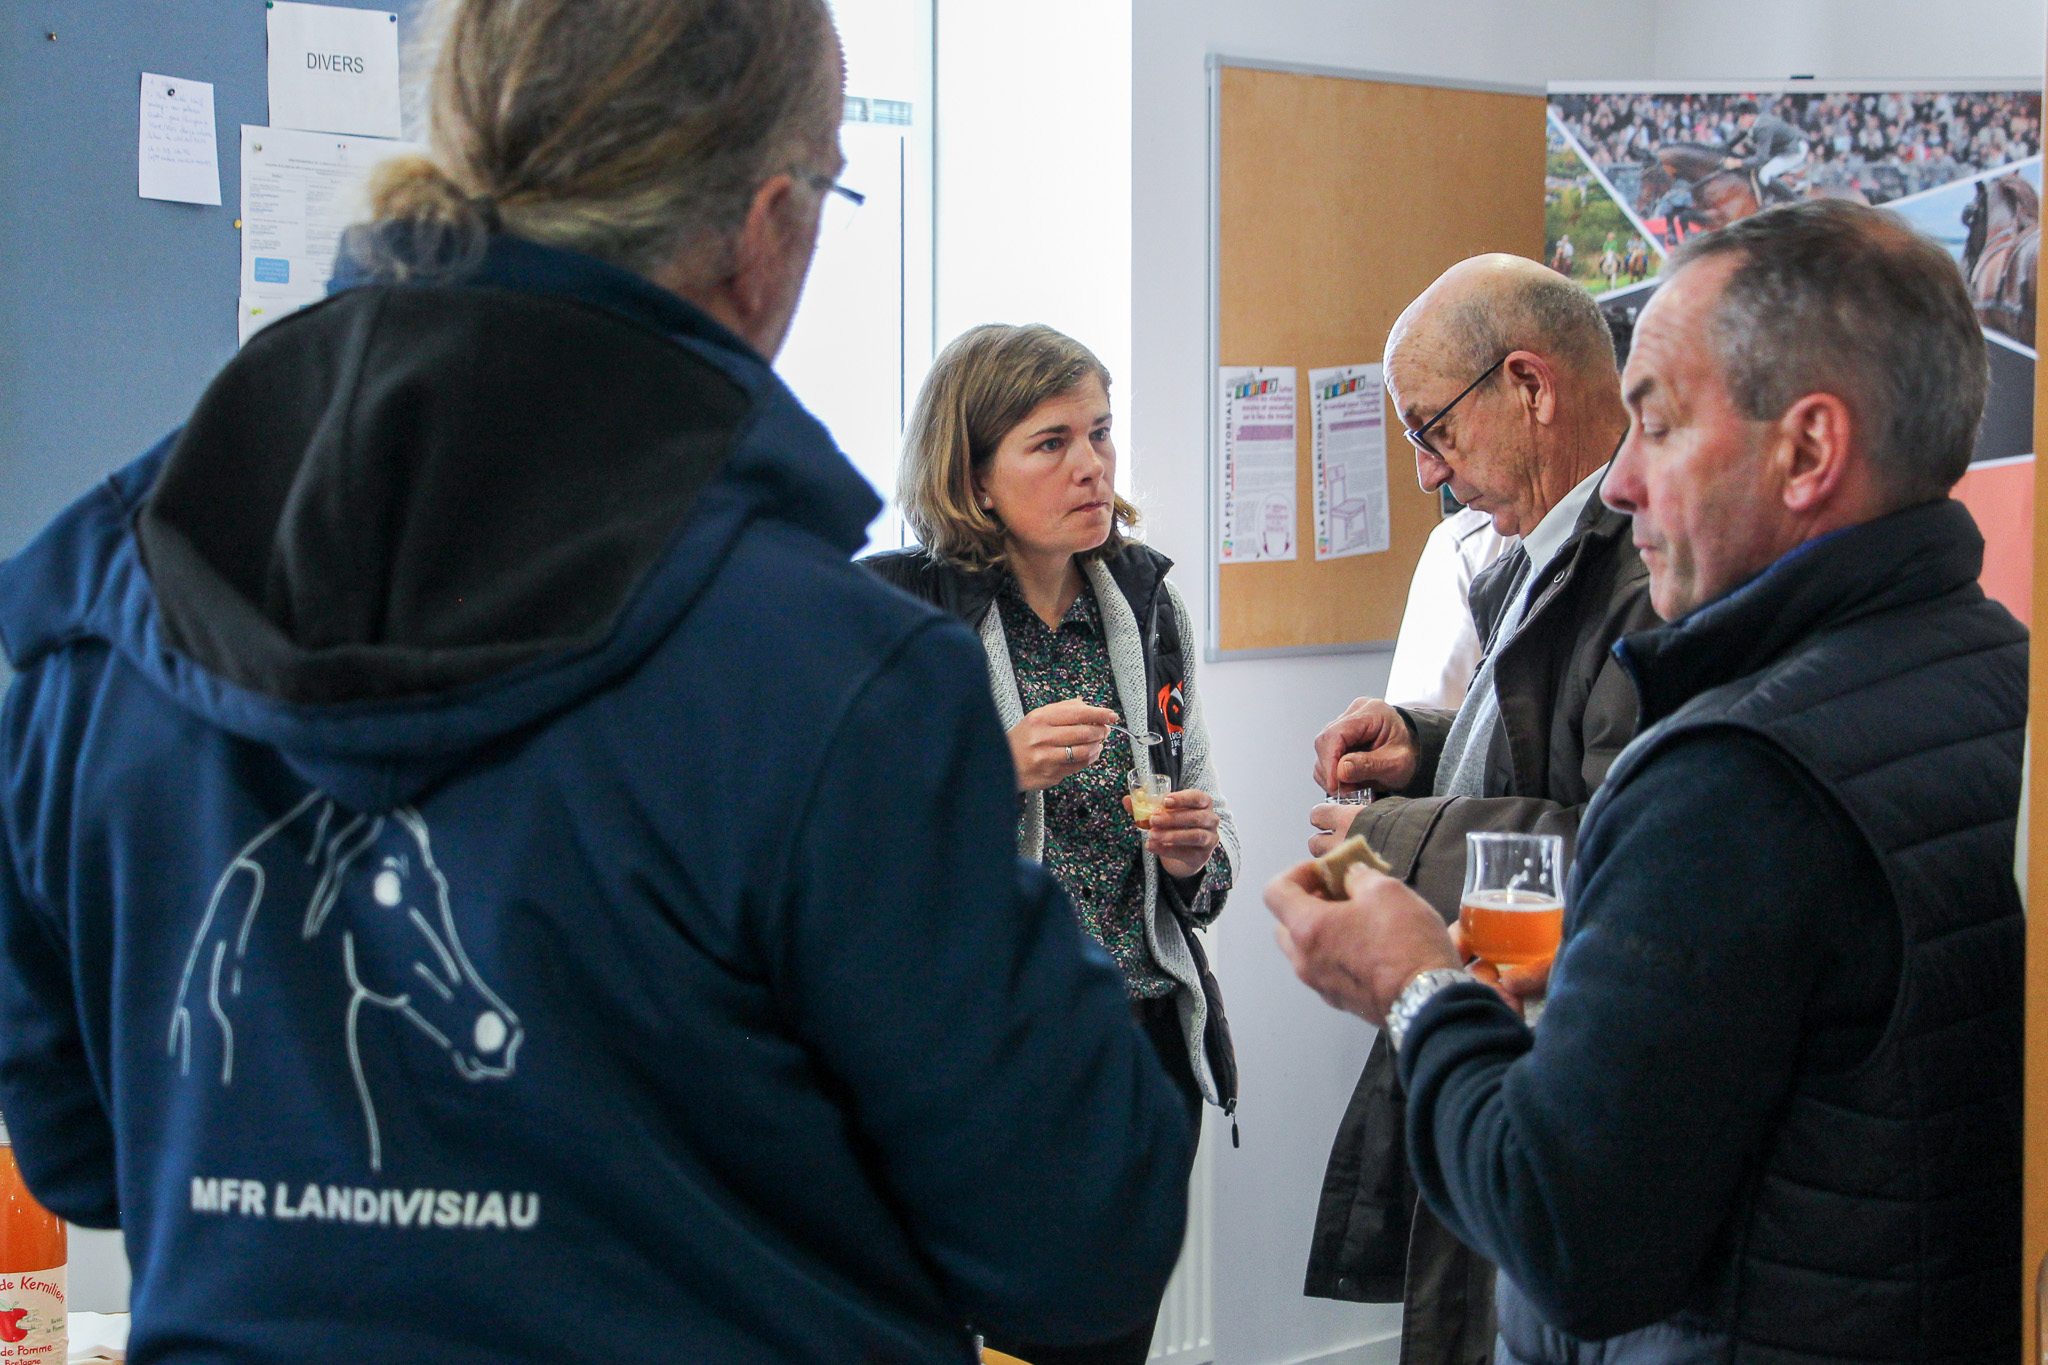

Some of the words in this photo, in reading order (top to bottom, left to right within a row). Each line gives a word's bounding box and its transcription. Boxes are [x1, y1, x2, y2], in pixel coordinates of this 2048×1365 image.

[307, 52, 364, 74] DIVERS
[191, 1176, 266, 1218] MFR
[274, 1182, 540, 1228] LANDIVISIAU
[0, 1278, 15, 1291] de
[20, 1275, 65, 1304] Kernilien
[0, 1346, 15, 1357] de
[17, 1344, 53, 1356] Pomme
